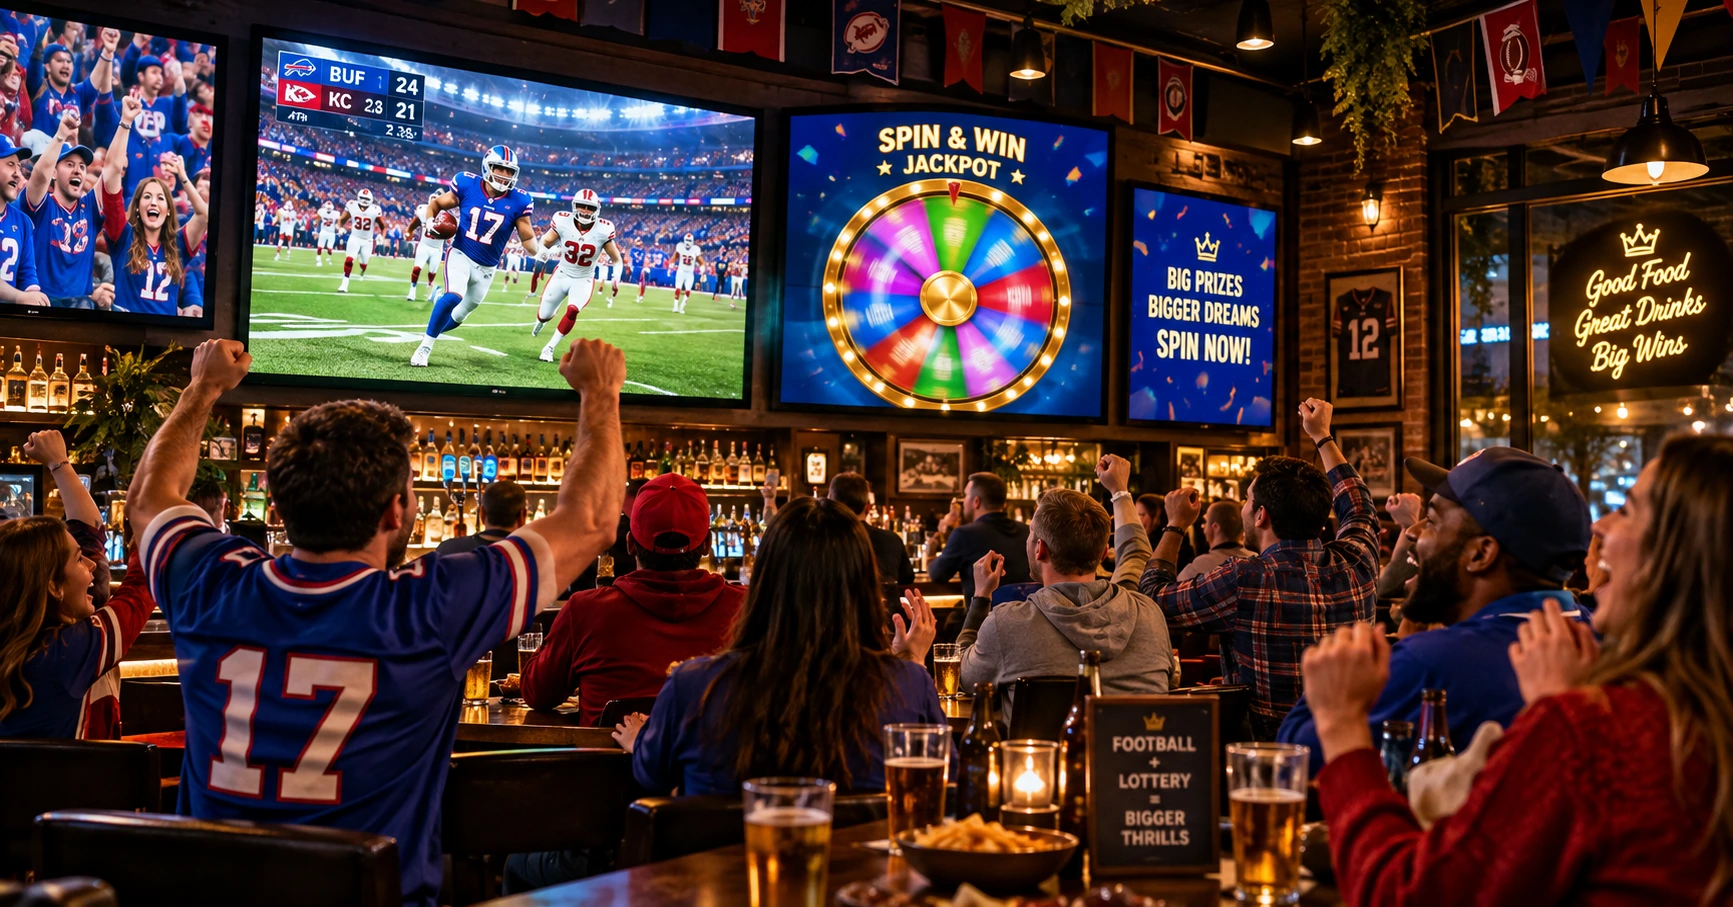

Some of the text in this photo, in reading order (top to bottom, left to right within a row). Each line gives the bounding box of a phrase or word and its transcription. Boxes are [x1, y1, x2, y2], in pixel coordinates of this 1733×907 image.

[329, 66, 366, 86] BUF
[395, 76, 419, 96] 24
[328, 91, 352, 109] KC
[395, 101, 415, 120] 21
[878, 124, 1026, 163] SPIN & WIN
[903, 153, 1001, 180] JACKPOT
[354, 216, 372, 231] 32
[465, 206, 505, 246] 17
[564, 240, 597, 267] 32
[140, 259, 172, 301] 12
[1167, 266, 1243, 298] BIG PRIZES
[1586, 251, 1691, 308] Good Food
[1148, 294, 1260, 328] BIGGER DREAMS
[1574, 304, 1632, 347] Great
[1635, 287, 1707, 326] Drinks
[1156, 328, 1251, 365] SPIN NOW!
[1348, 317, 1379, 360] 12
[1590, 330, 1688, 380] Big Wins
[207, 644, 378, 804] 17
[1112, 735, 1197, 752] FOOTBALL
[1118, 773, 1192, 789] LOTTERY
[1124, 810, 1186, 826] BIGGER
[1120, 830, 1190, 846] THRILLS
